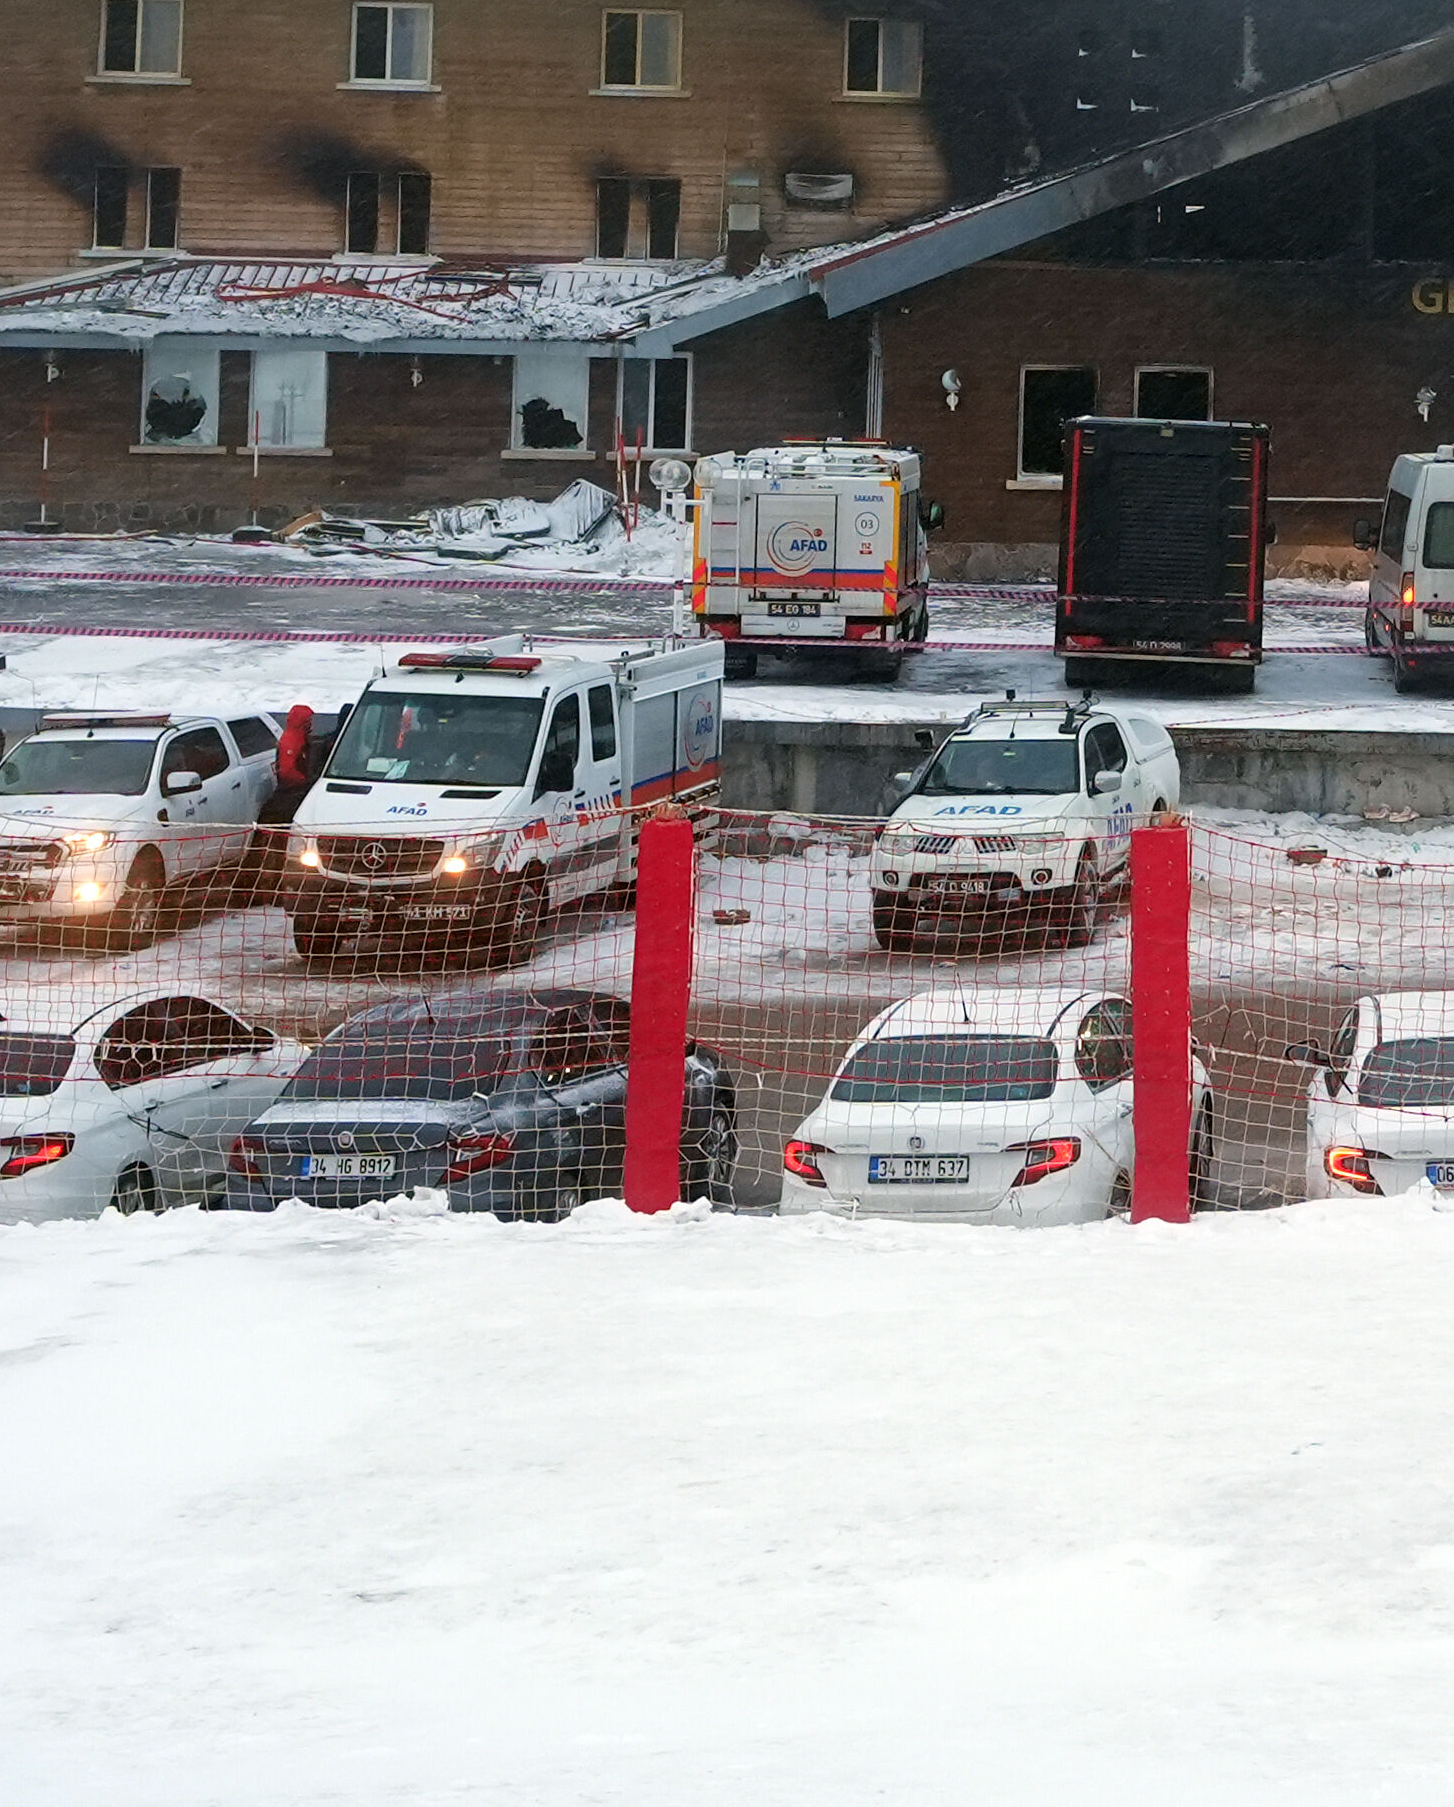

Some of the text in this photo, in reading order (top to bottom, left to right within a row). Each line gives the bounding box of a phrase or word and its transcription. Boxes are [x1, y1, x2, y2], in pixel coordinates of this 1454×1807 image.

[860, 519, 874, 529] 03
[790, 539, 827, 552] AFAD
[771, 604, 783, 614] 54
[695, 715, 714, 737] AFAD
[386, 806, 427, 816] AFAD
[933, 805, 1023, 817] AFAD
[879, 1160, 896, 1177] 34
[938, 1160, 964, 1177] 637
